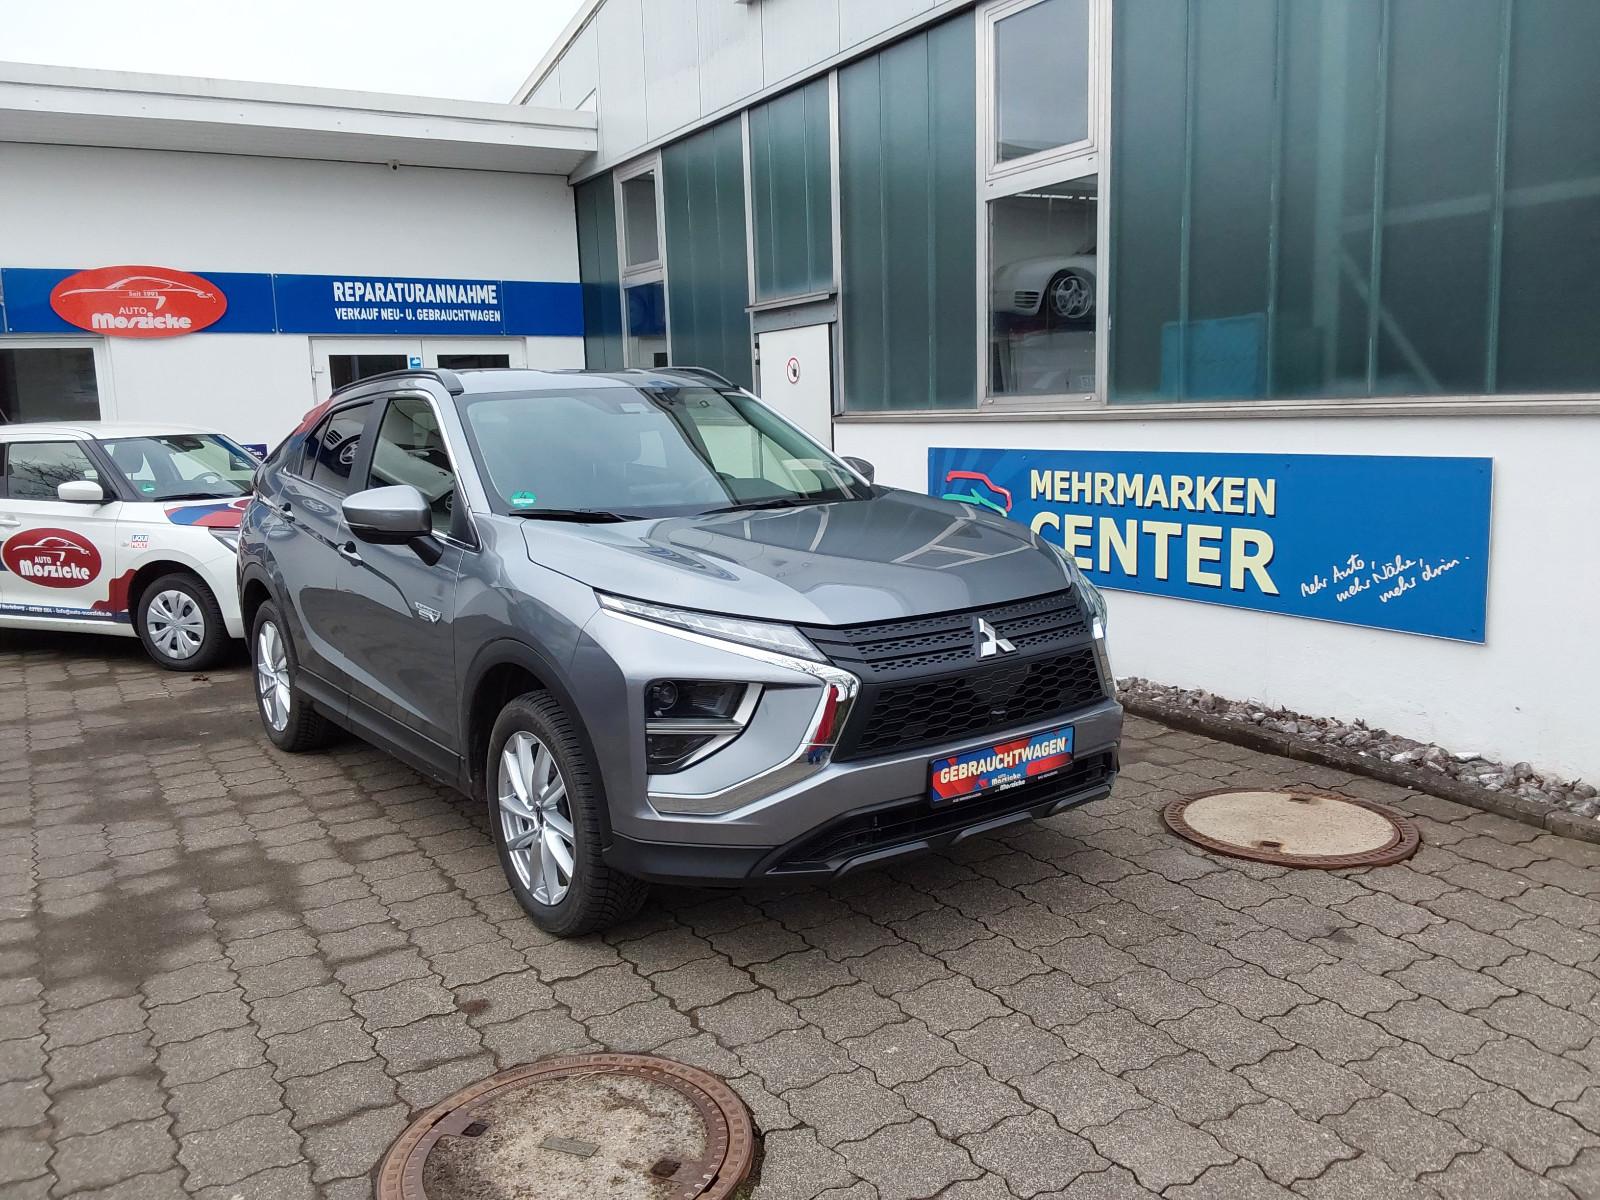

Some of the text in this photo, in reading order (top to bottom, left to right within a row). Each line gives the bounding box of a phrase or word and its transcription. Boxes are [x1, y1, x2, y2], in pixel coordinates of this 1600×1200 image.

[332, 281, 498, 304] REPARATURANNAHME
[119, 306, 147, 315] AUTO
[334, 307, 501, 322] VERKAUF NEU- U. GEBRAUCHTWAGEN
[1030, 469, 1276, 516] MEHRMARKEN
[34, 556, 52, 564] AUTO
[1300, 575, 1328, 597] Mehr
[1336, 577, 1371, 602] mehr
[1379, 576, 1417, 603] mehr
[940, 736, 1066, 783] GEBRAUCHTWAGEN
